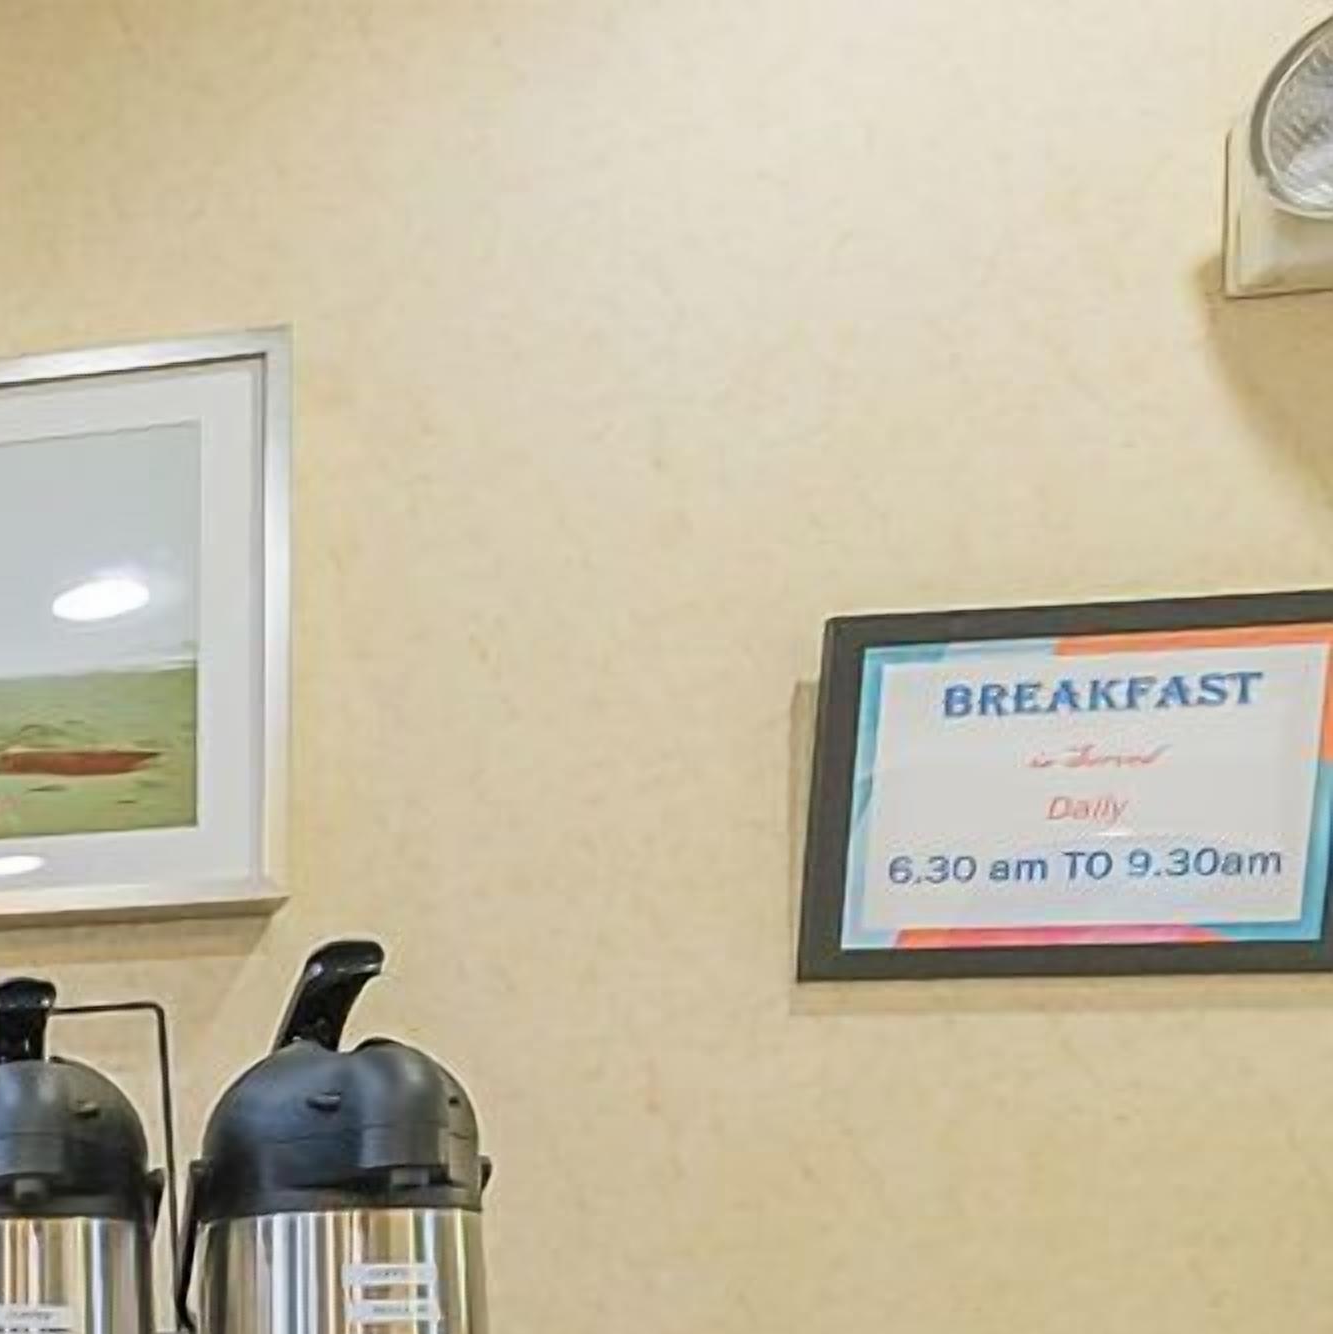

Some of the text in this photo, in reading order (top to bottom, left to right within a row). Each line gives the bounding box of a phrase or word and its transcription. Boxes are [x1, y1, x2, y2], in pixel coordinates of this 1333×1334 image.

[943, 671, 1264, 717] BREAKFAST
[1045, 796, 1128, 825] Daily
[888, 847, 1283, 885] 6.30 am TO 9.30am
